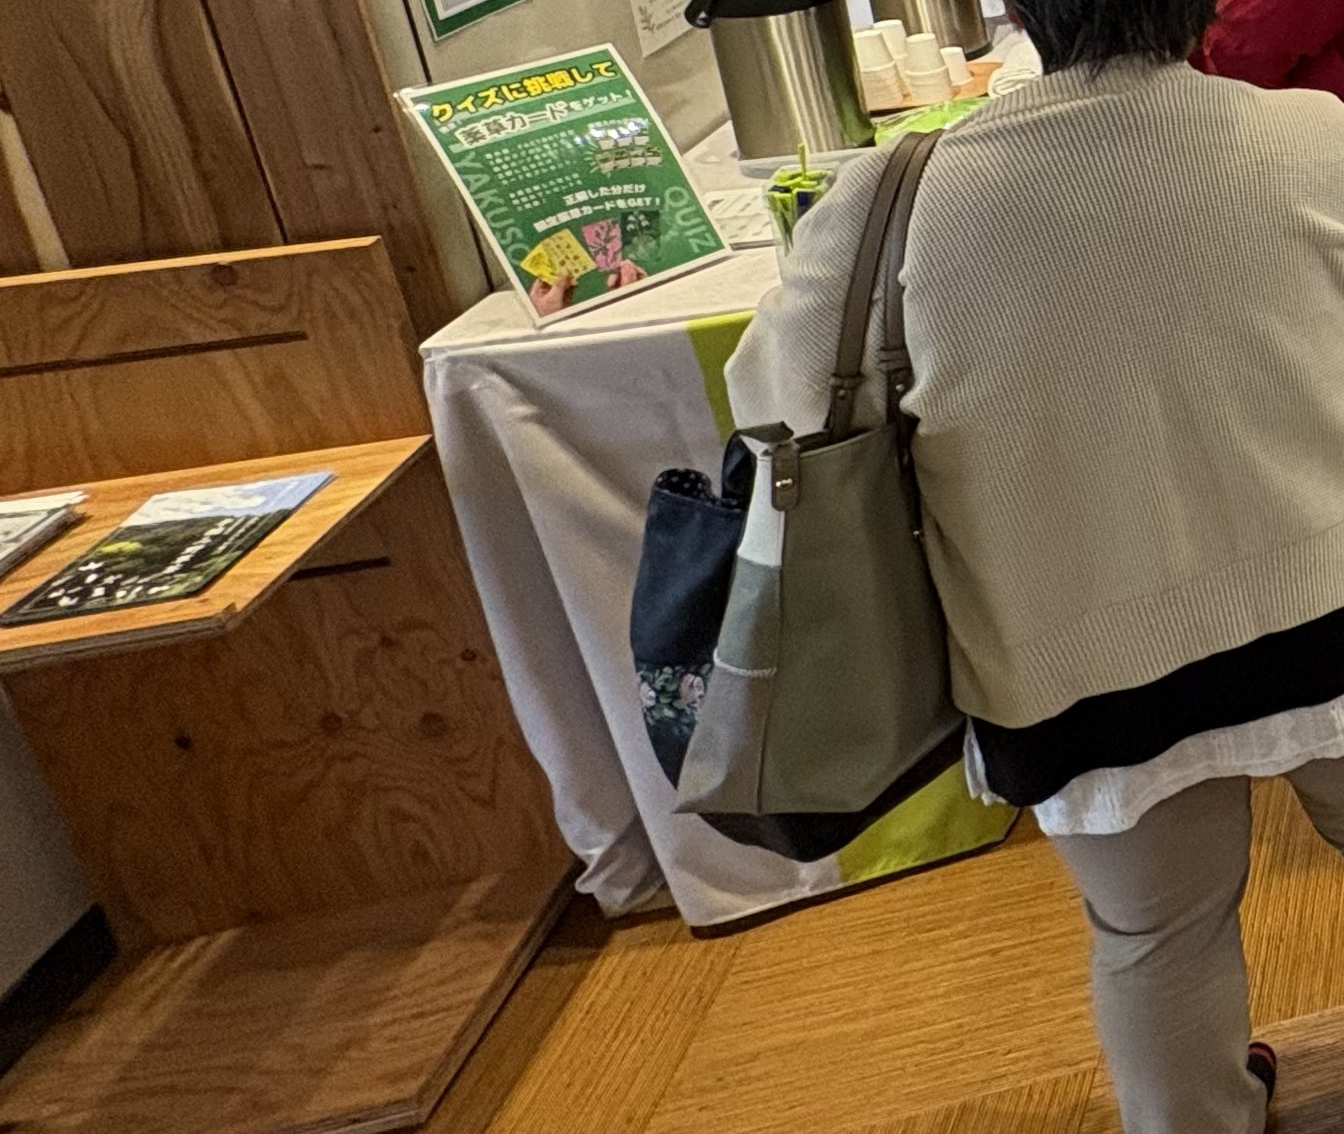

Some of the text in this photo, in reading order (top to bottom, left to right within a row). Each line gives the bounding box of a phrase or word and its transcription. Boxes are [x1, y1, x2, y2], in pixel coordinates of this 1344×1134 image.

[430, 60, 617, 124] クイズに挑戦して
[663, 185, 718, 253] QUIZ
